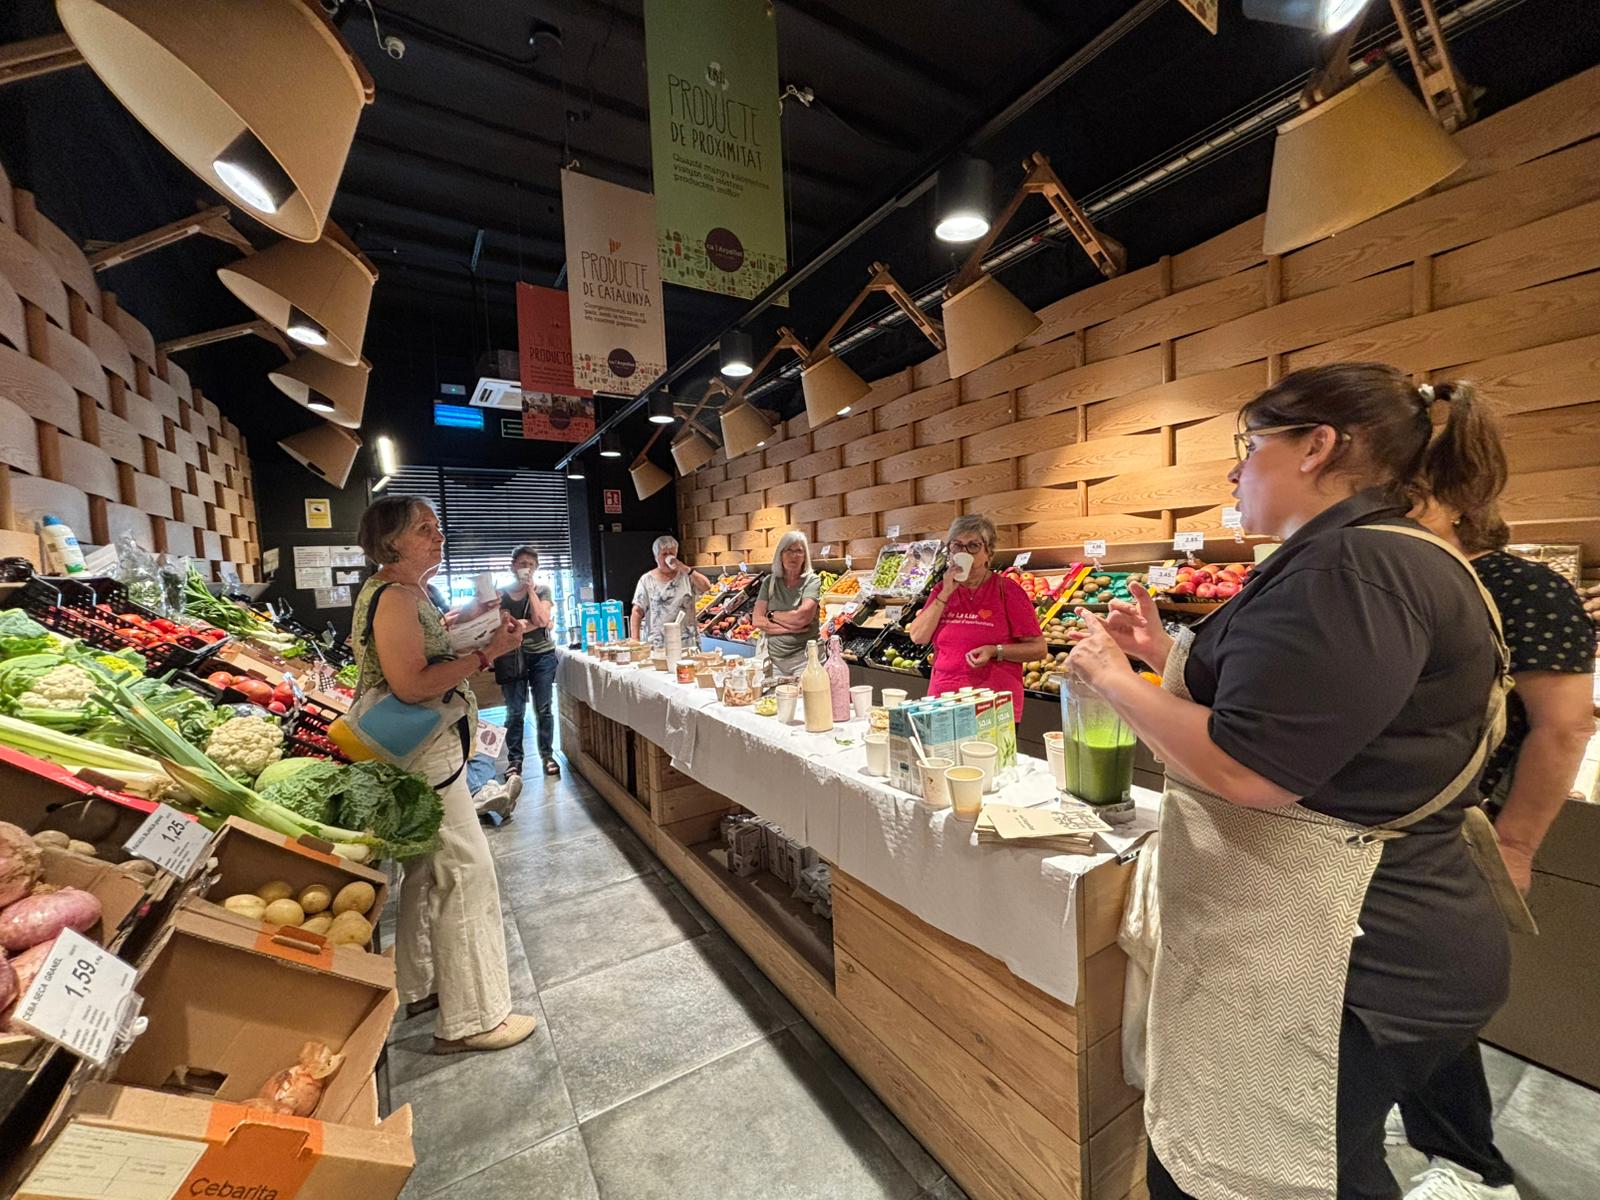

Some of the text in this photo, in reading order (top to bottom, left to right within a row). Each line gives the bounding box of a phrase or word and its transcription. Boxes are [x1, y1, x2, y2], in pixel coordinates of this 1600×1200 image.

[668, 74, 762, 146] PRODUCTE
[671, 121, 762, 171] DE PROXIMITAT
[581, 251, 649, 291] PRODUCTE
[583, 282, 651, 307] DE CATALUNYA
[978, 718, 992, 730] SOJA
[997, 712, 1010, 722] SOJA
[159, 818, 187, 846] 1,25
[21, 955, 62, 1022] CEBA SECA GRANEL
[61, 956, 101, 1004] 1,59
[189, 1177, 278, 1200] Cebarita
